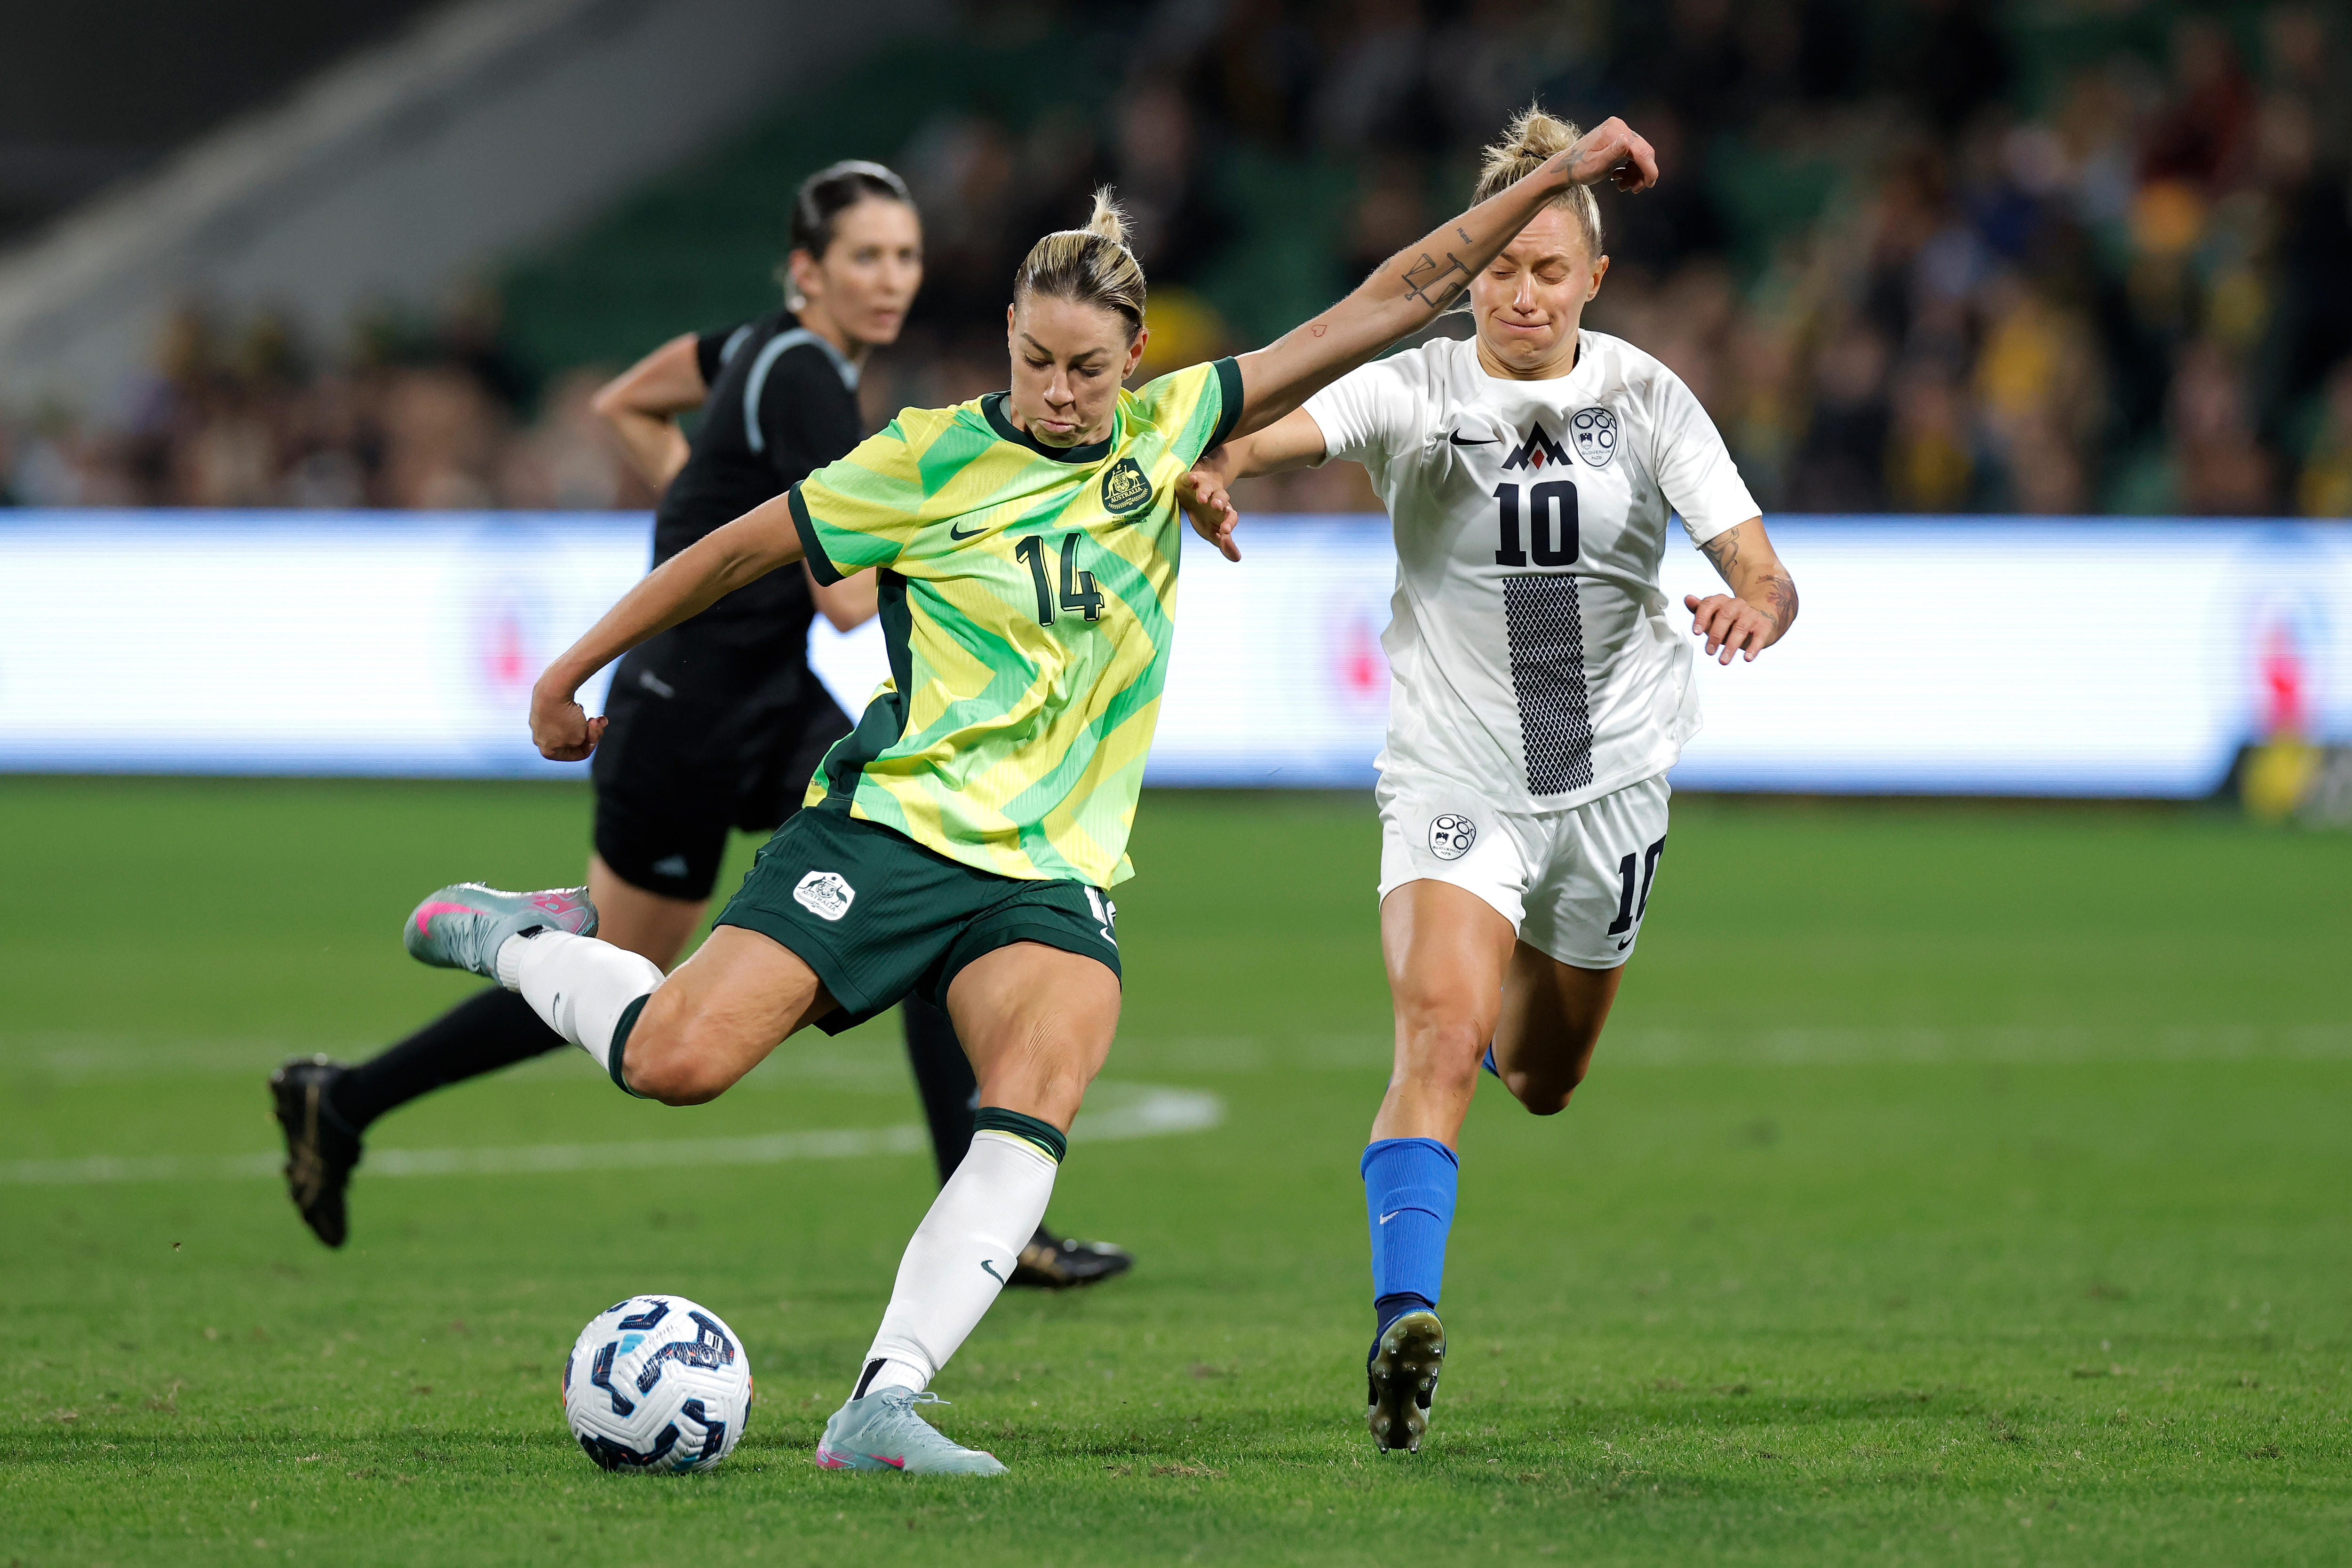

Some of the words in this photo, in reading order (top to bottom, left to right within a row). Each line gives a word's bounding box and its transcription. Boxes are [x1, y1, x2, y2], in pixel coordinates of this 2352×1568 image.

[1111, 487, 1143, 503] AUSTRALIA
[1493, 480, 1579, 567] 10
[1015, 533, 1104, 627] 14
[801, 890, 835, 911] AUSTRALIA
